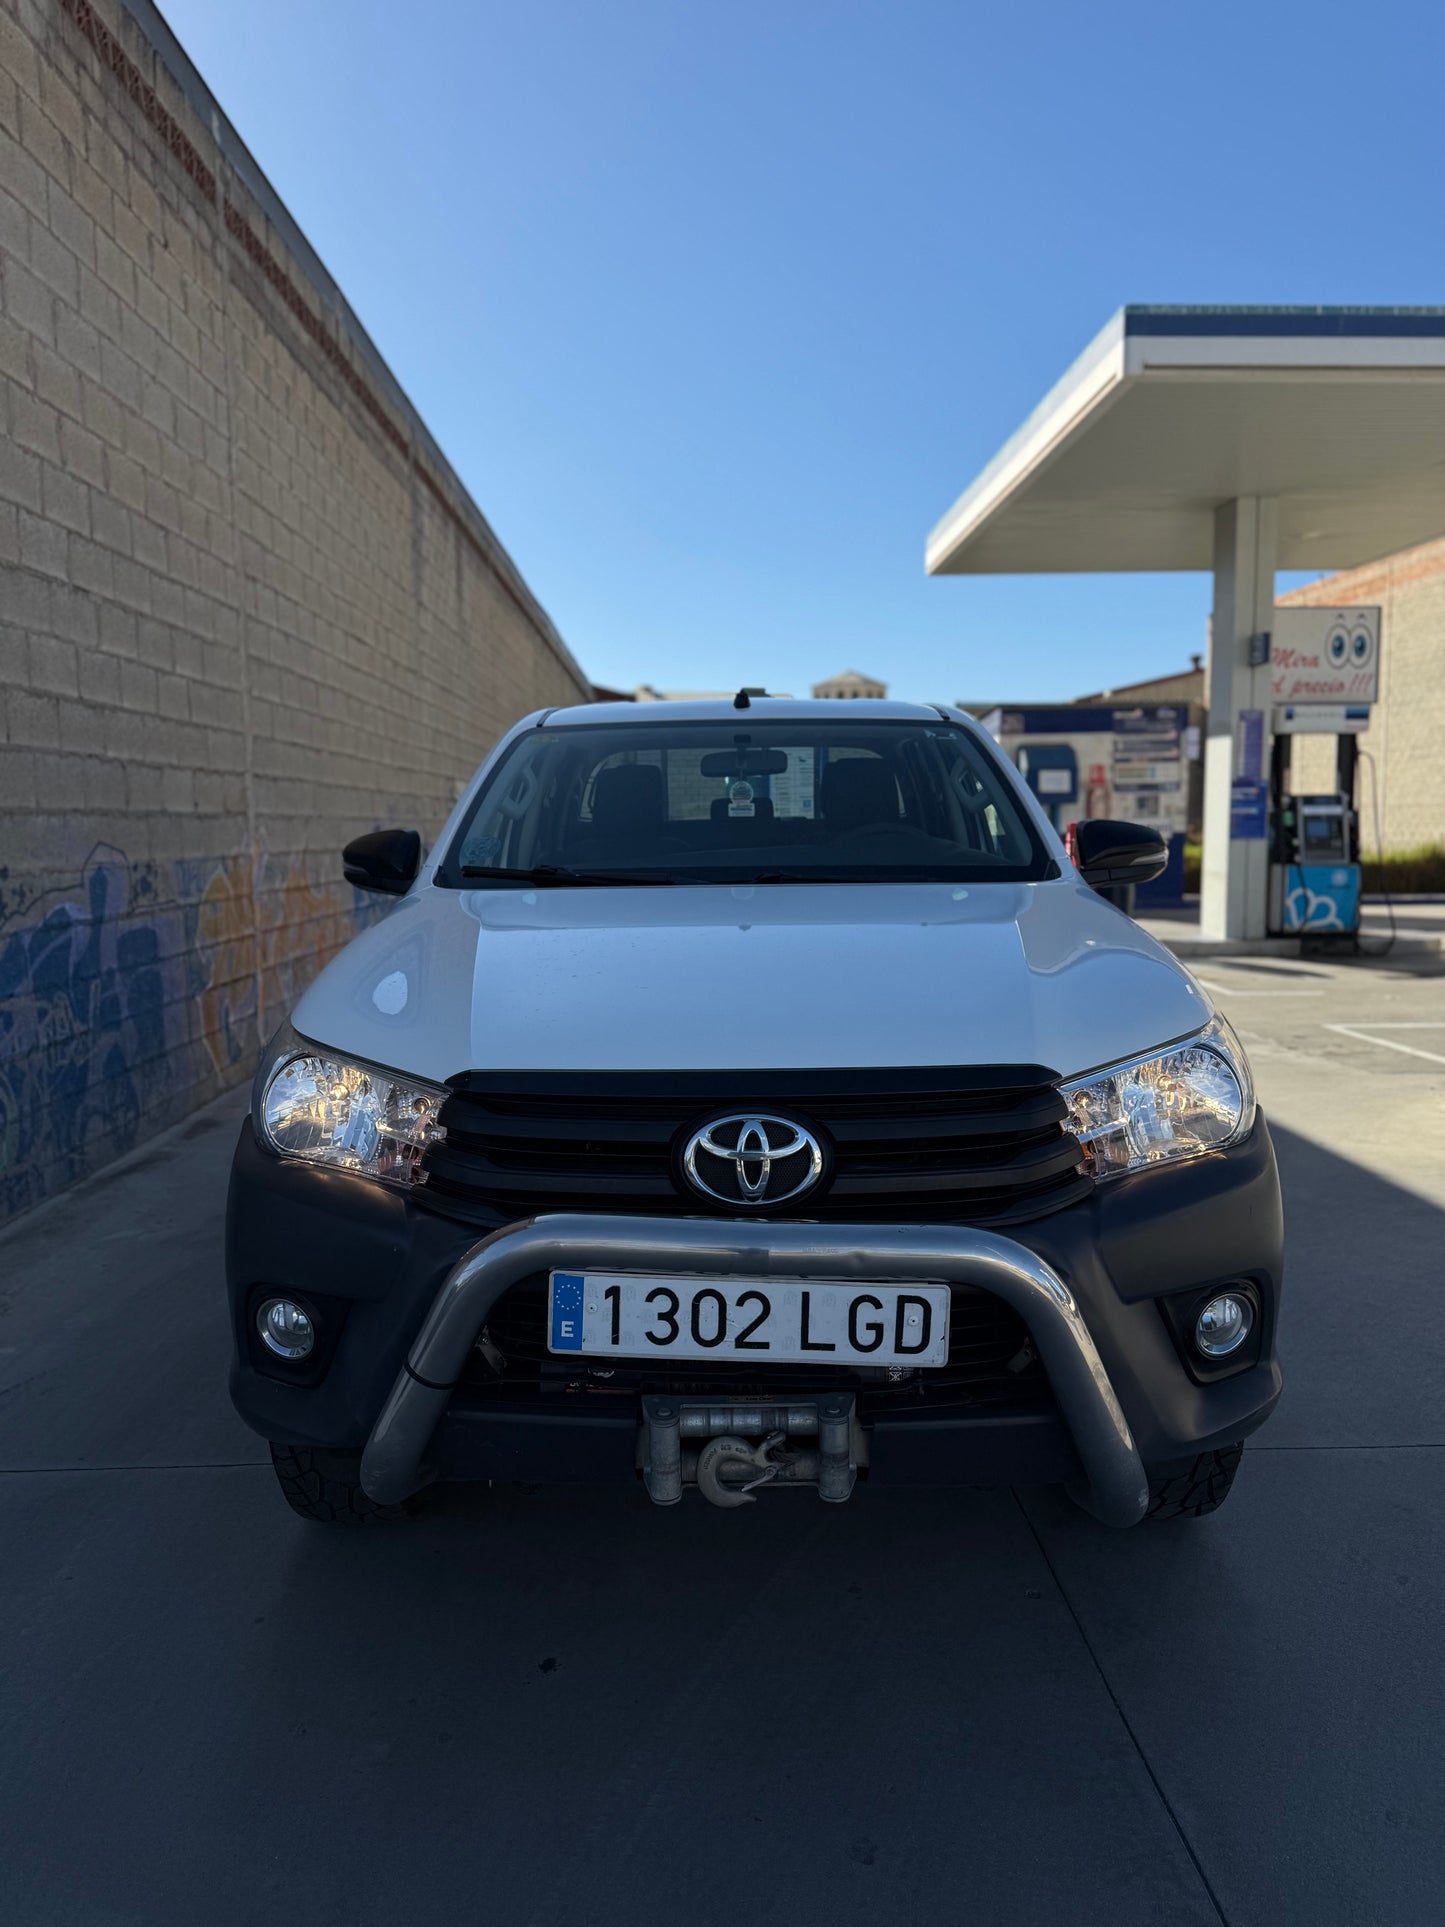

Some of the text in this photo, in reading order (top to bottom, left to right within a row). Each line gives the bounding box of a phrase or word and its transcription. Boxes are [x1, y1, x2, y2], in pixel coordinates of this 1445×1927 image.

[561, 1321, 574, 1338] E
[604, 1285, 932, 1354] 1302 LGD
